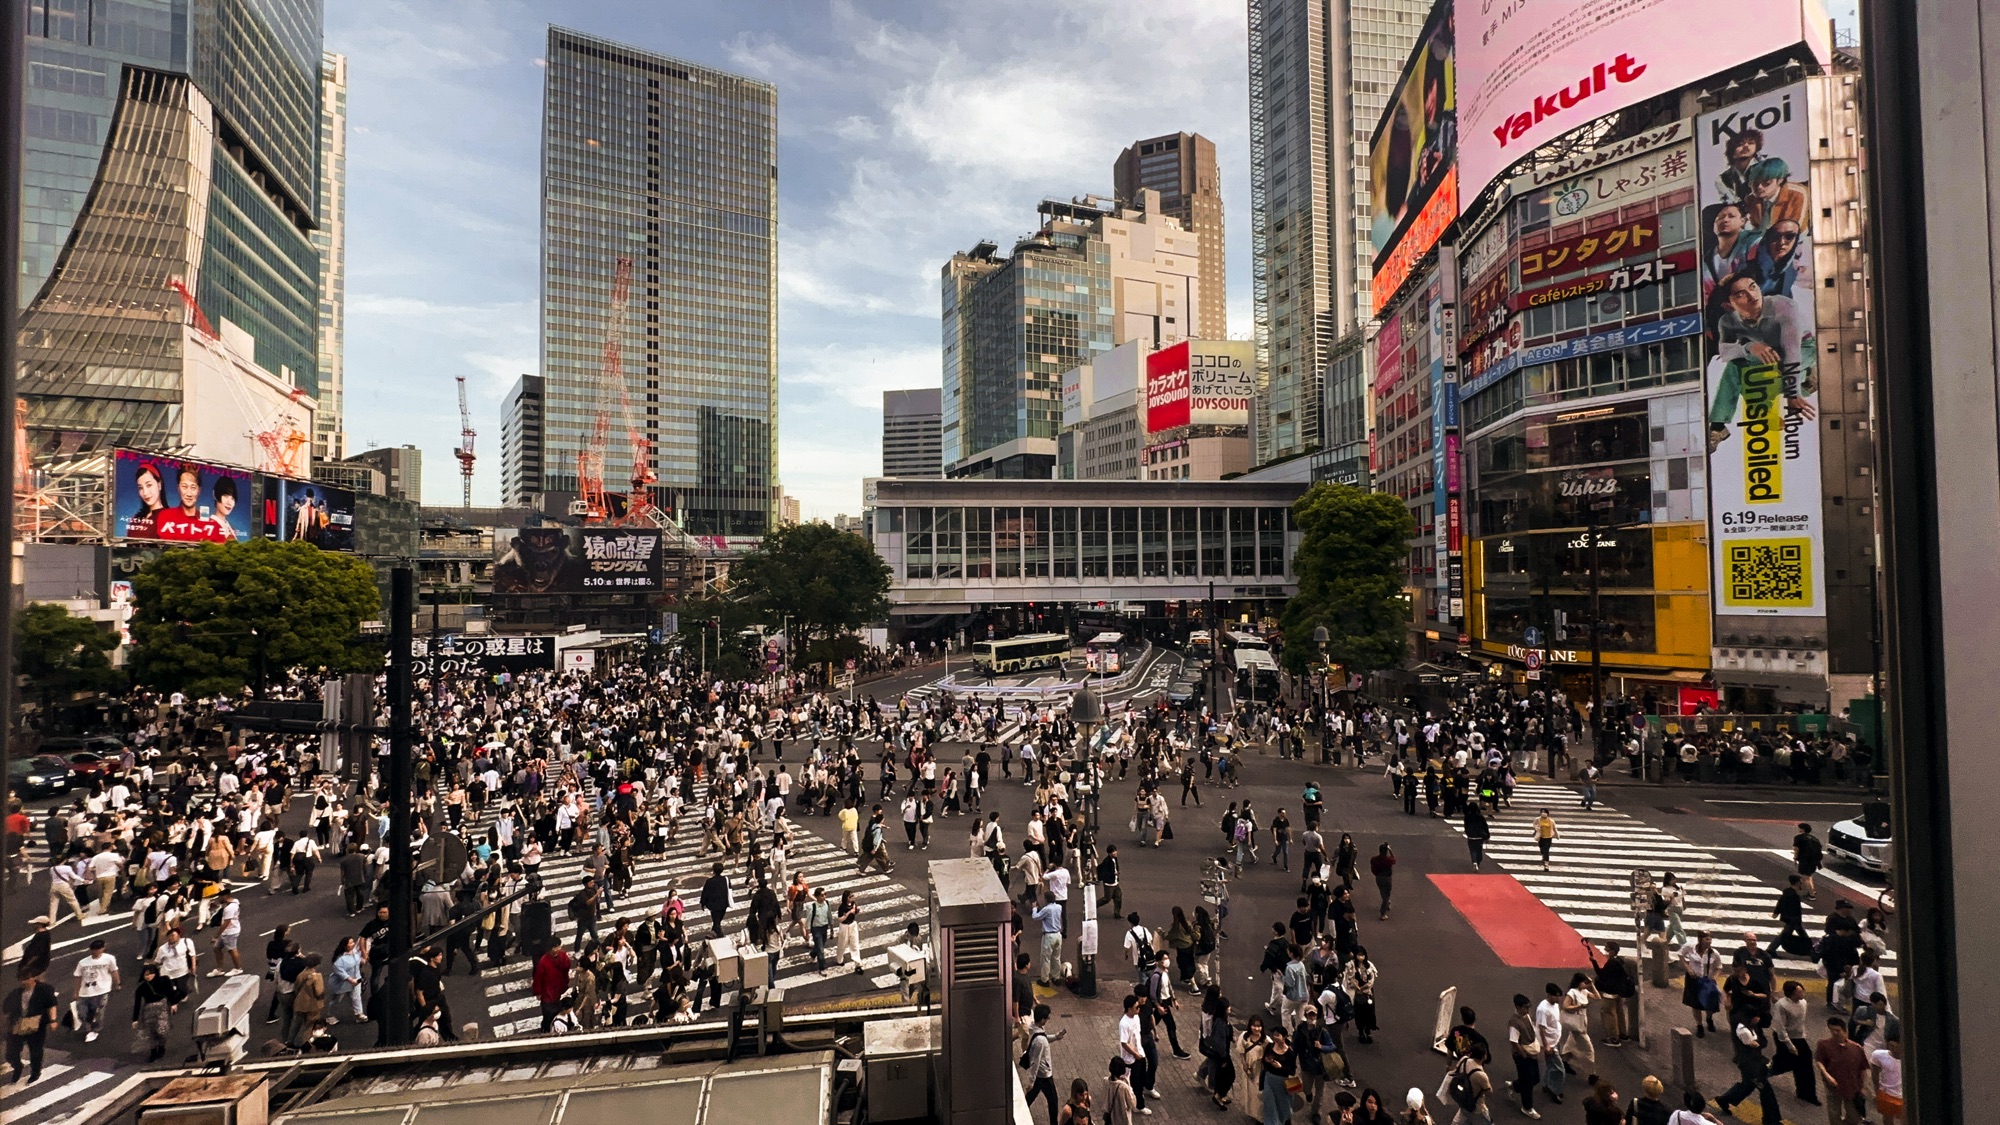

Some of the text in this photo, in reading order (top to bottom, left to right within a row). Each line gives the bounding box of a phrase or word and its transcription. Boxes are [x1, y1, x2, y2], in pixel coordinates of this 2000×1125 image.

[1493, 53, 1647, 148] Yakult
[1712, 94, 1791, 146] Kroi
[1598, 151, 1687, 199] しゃぶ葉
[1522, 224, 1653, 275] コンタクト
[1609, 260, 1675, 291] ガスト
[1192, 355, 1242, 368] ココロの
[1527, 345, 1562, 361] AEON
[1149, 369, 1187, 396] カラオケ
[1148, 387, 1189, 409] JOYSOUND
[1191, 398, 1248, 410] JOYSOUN
[1782, 362, 1803, 460] New Album
[1434, 379, 1444, 489] アイシティ
[1737, 365, 1780, 501] Unspoiled
[1339, 473, 1358, 483] CITY
[161, 522, 215, 536] ペイトク
[1722, 511, 1809, 525] 6.19 Release
[583, 535, 657, 560] 猿の惑星
[591, 560, 647, 572] キングダム
